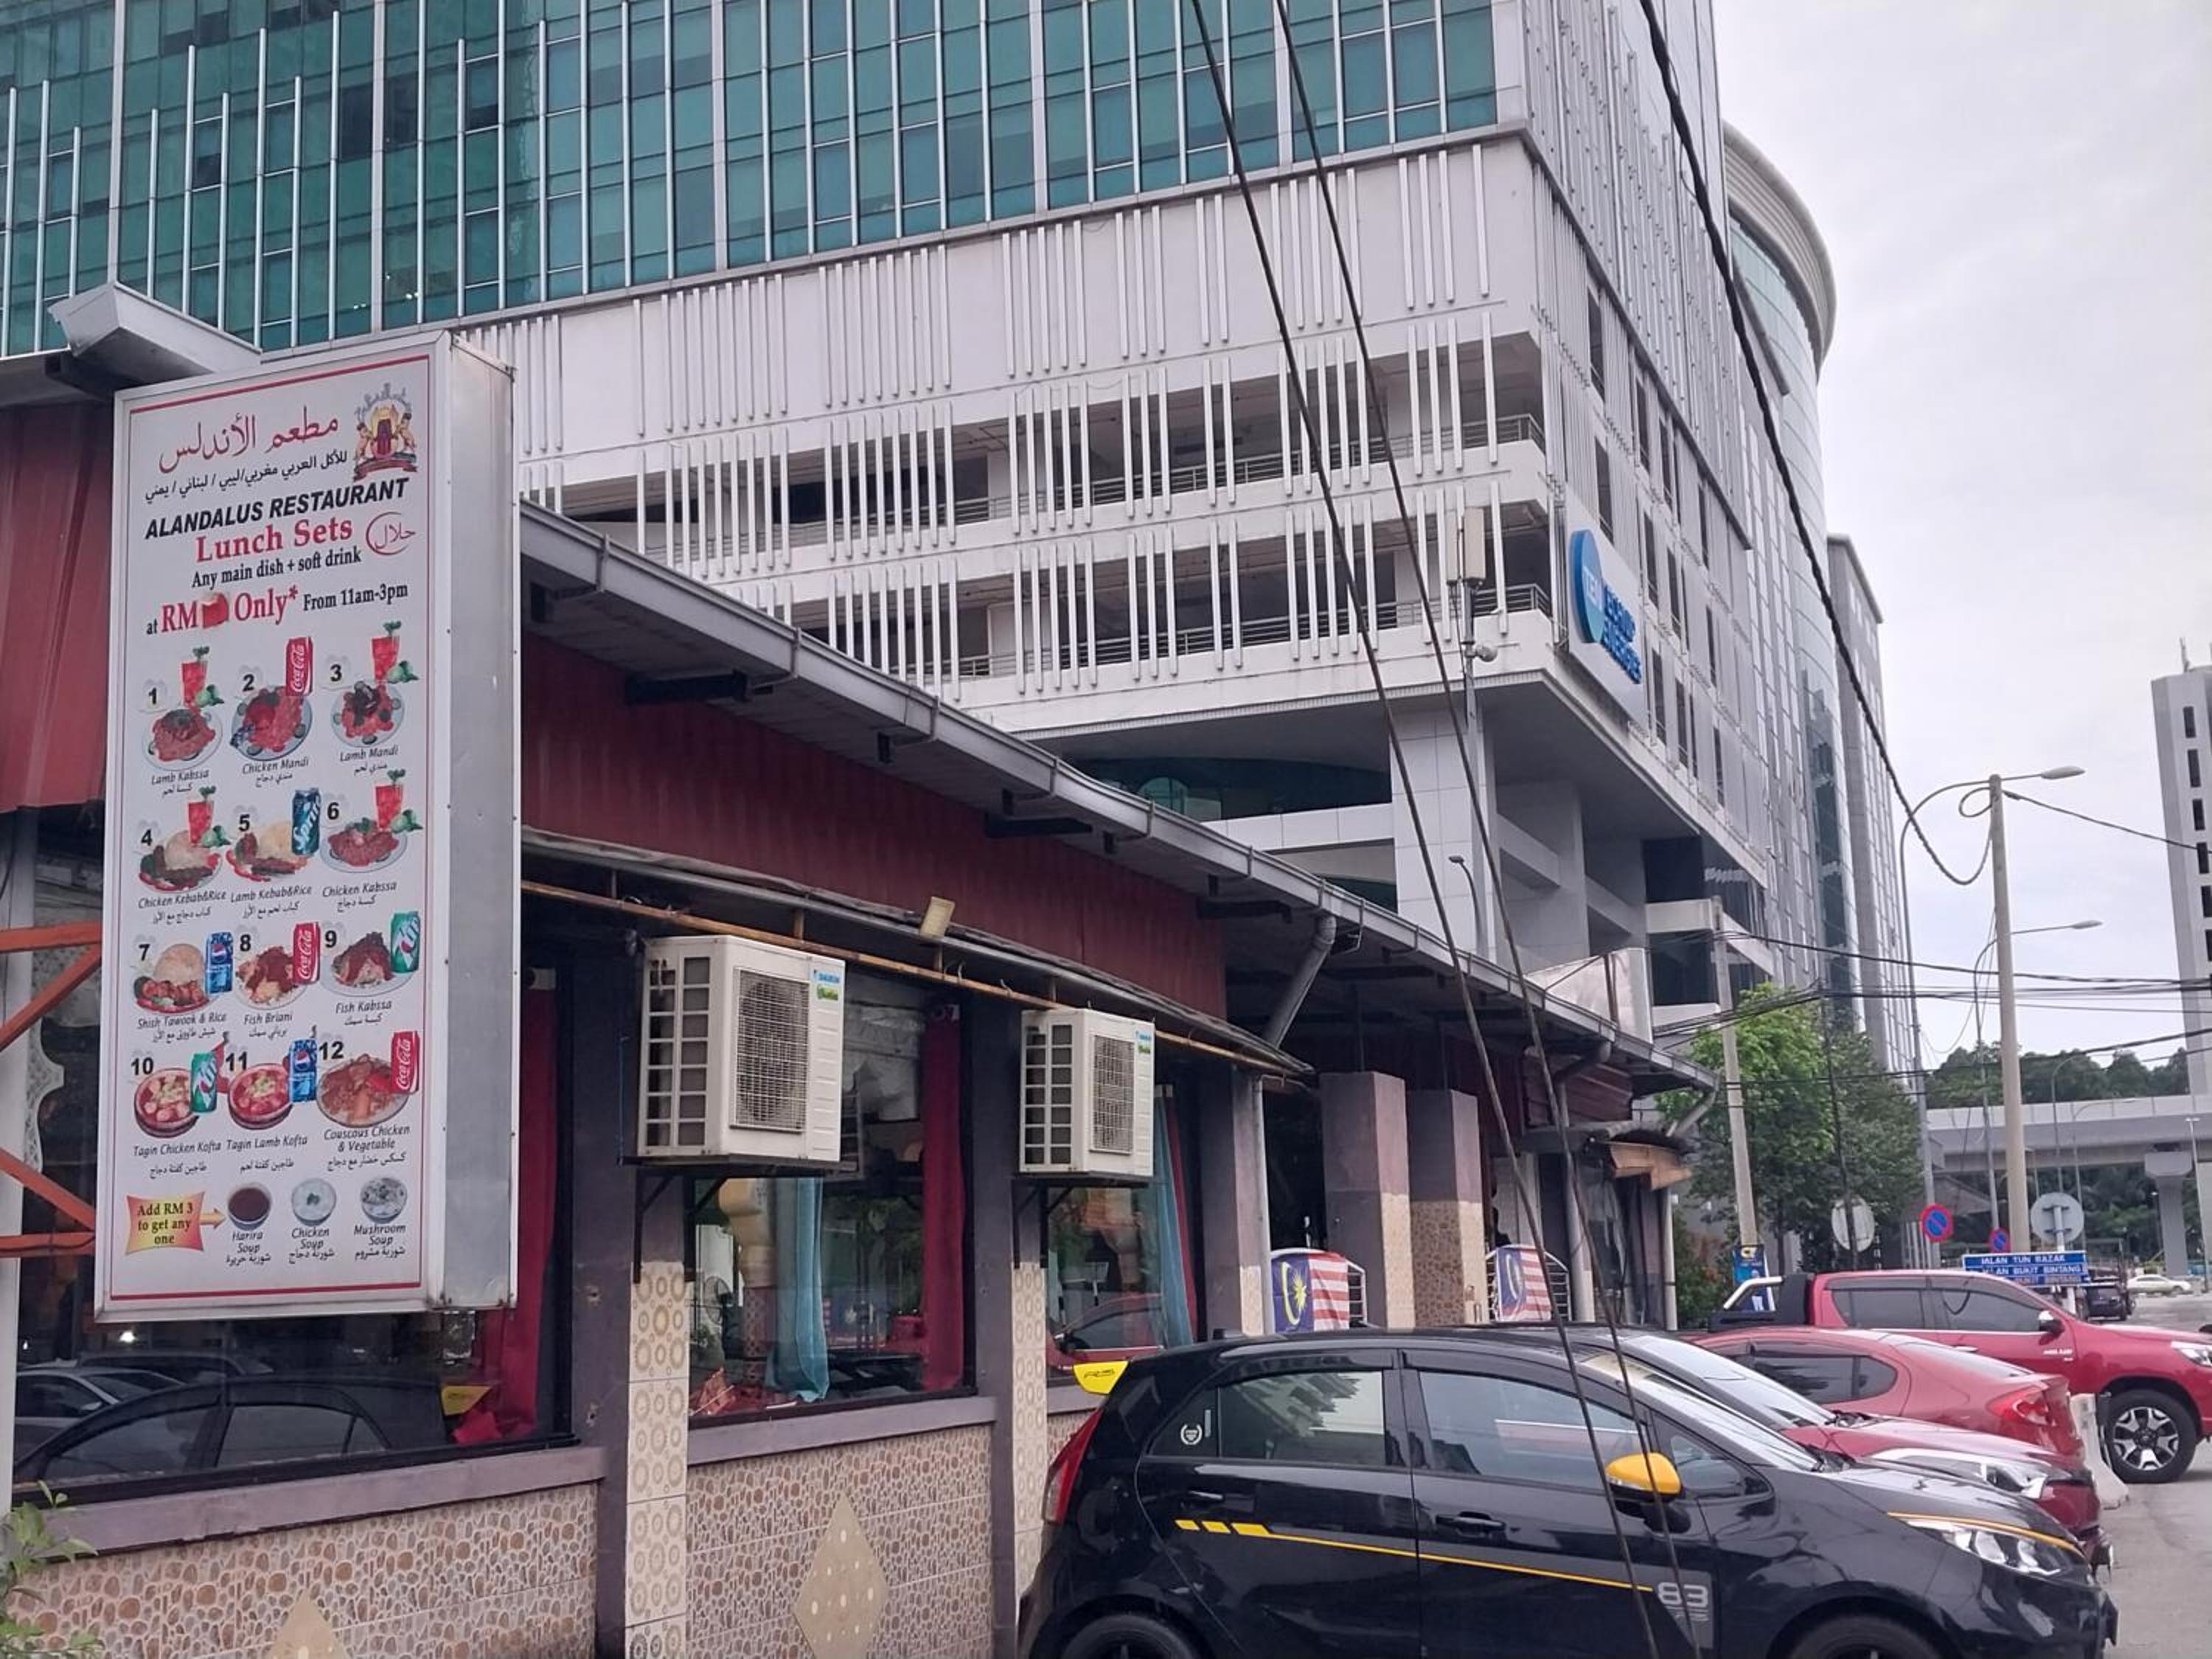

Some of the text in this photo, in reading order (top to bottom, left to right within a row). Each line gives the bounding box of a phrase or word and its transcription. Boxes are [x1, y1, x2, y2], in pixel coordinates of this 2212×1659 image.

[264, 406, 339, 454] مطعم
[145, 478, 409, 539] ALANDALUS RESTAURANT
[195, 517, 352, 563] Lunch Sets
[192, 571, 218, 590] Any
[221, 563, 253, 582] main
[256, 558, 284, 577] dish
[298, 552, 321, 572] soft
[325, 546, 361, 567] drink
[147, 620, 158, 635] at
[303, 592, 337, 612] From
[340, 582, 408, 605] 11am-3pm
[330, 664, 342, 681] 3
[243, 675, 254, 692] 2
[148, 688, 158, 704] 1
[340, 745, 399, 762] Lamb Mandi
[242, 757, 309, 774] Chicken Mandi
[152, 773, 175, 785] Lamb
[327, 802, 340, 820] 6
[239, 815, 251, 832] 5
[141, 830, 153, 846] 4
[231, 890, 256, 903] Lamb
[322, 884, 361, 897] Chicken
[138, 897, 173, 909] Chicken
[240, 934, 251, 952] 8
[325, 930, 337, 948] 9
[139, 944, 150, 961] 7
[335, 1002, 355, 1015] Fish
[209, 1012, 226, 1023] Rice
[243, 1012, 293, 1026] Fish Briani
[319, 1042, 344, 1060] 12
[131, 1057, 154, 1076] 10
[226, 1052, 248, 1071] 11
[324, 1124, 411, 1141] Couscous Chicken
[133, 1141, 222, 1159] Tagin Chicken Kofta
[226, 1135, 307, 1152] Tagin Lamb Kofta
[348, 1138, 396, 1152] Vegetable
[138, 1203, 193, 1217] Add RM 3
[138, 1220, 191, 1234] to get any
[291, 1227, 330, 1239] Chicken
[354, 1225, 406, 1235] Mushroom
[154, 1235, 175, 1245] one
[237, 1242, 260, 1254] Soup
[300, 1239, 324, 1250] Soup
[369, 1236, 394, 1246] Soup
[2014, 1255, 2031, 1264] TUN
